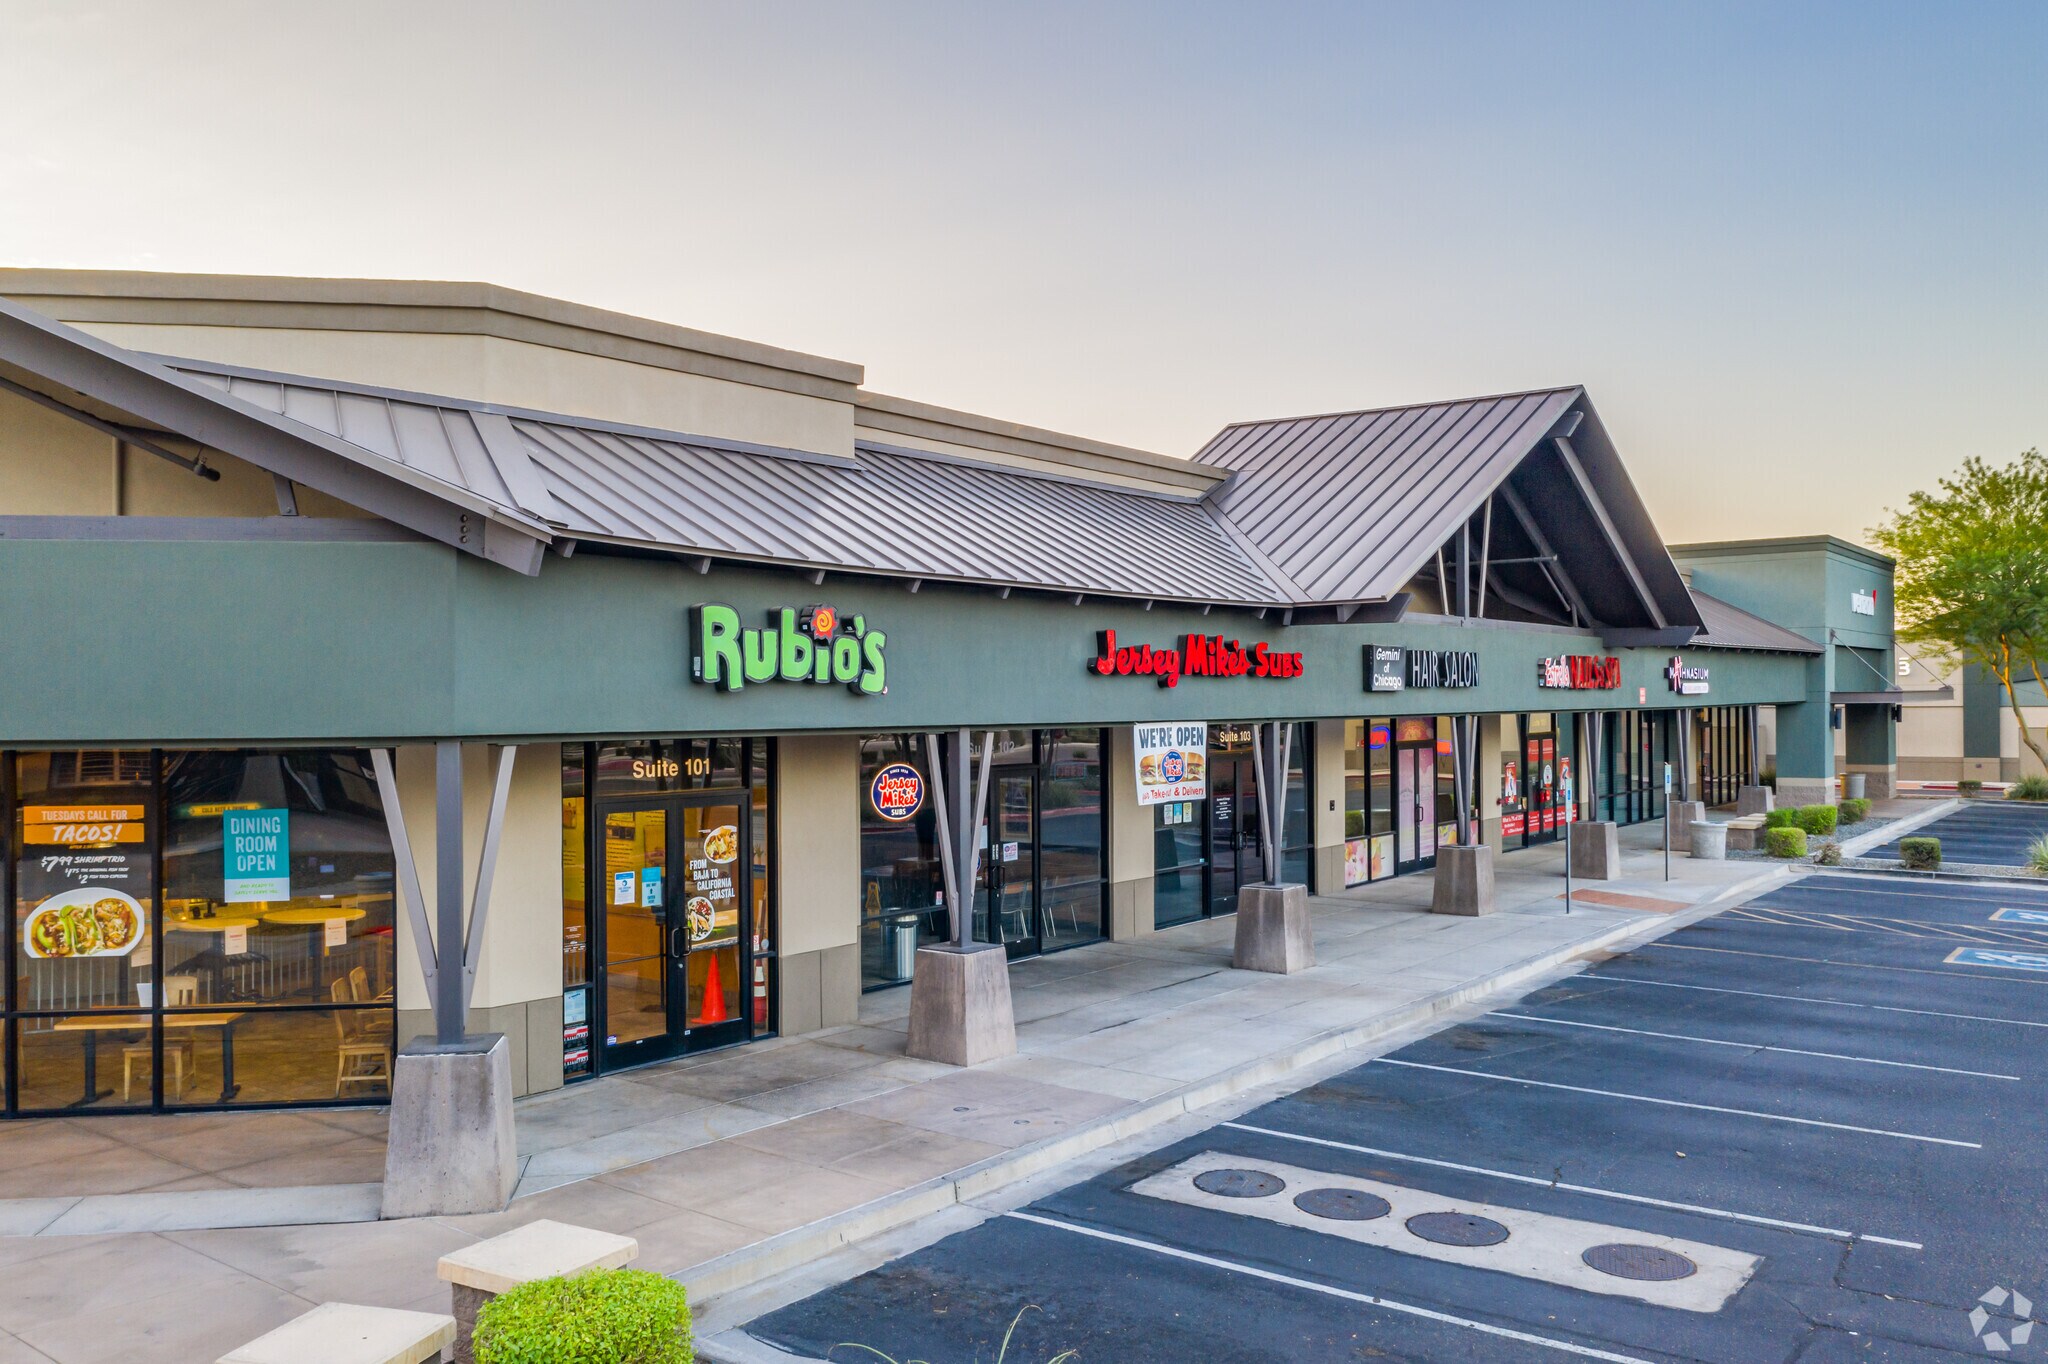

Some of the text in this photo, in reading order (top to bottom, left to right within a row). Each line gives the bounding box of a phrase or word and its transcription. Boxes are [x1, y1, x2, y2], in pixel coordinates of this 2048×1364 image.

[697, 602, 888, 696] Rubio's
[1376, 648, 1401, 660] Gemini
[1094, 629, 1180, 689] Jersey
[1184, 633, 1251, 678] Mike's
[1383, 662, 1391, 673] of
[1412, 650, 1479, 688] HAIR SALON
[1544, 654, 1571, 689] Estrella
[1570, 655, 1600, 689] NAILS
[1373, 674, 1402, 690] Chicago
[1138, 726, 1204, 748] WE'RE OPEN
[1219, 730, 1251, 742] Suite 103
[998, 741, 1015, 754] 102
[632, 758, 711, 779] Suite 101
[878, 774, 918, 794] Jersey
[1174, 786, 1180, 797] &
[1182, 786, 1205, 797] Delivery
[880, 790, 918, 808] Mike's
[41, 810, 128, 821] TUESDAYS CALL FOR
[53, 824, 123, 842] TACOS!
[230, 816, 281, 834] DINING
[235, 836, 277, 853] ROOM
[74, 855, 107, 864] SHRIMP
[107, 855, 126, 863] TRIO
[237, 854, 276, 872] OPEN
[689, 858, 707, 870] FROM
[693, 868, 719, 880] BAJA TO
[696, 877, 732, 891] CALIFORNIA
[709, 888, 736, 900] COASTAL
